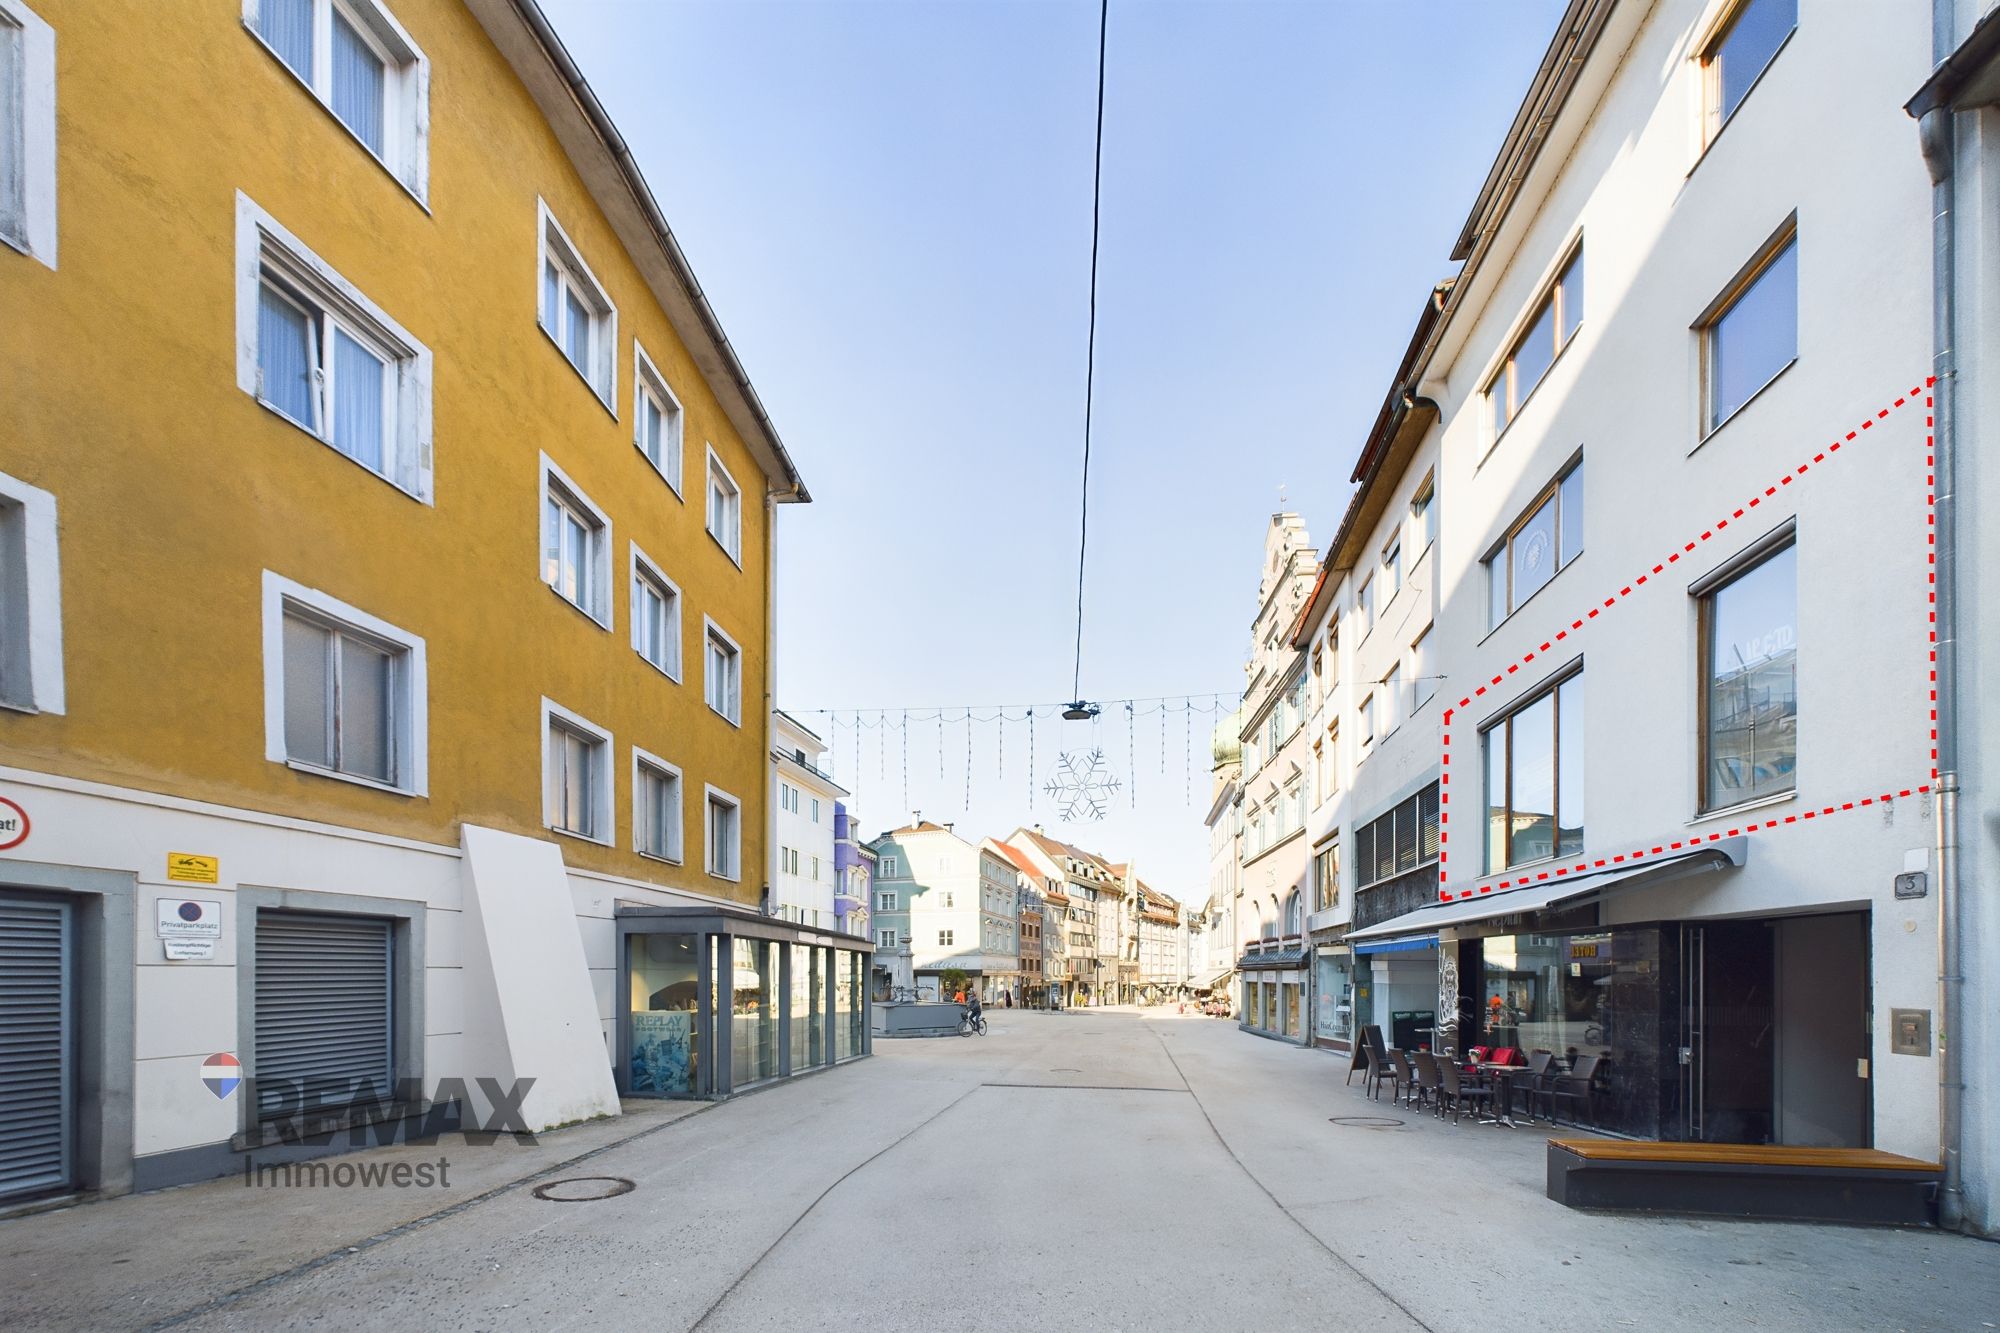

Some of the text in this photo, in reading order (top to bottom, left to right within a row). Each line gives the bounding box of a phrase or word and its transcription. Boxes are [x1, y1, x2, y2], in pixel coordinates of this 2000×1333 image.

[1905, 875, 1916, 890] 3
[161, 920, 218, 930] Privatparkplatz
[636, 1015, 683, 1026] REPLAY
